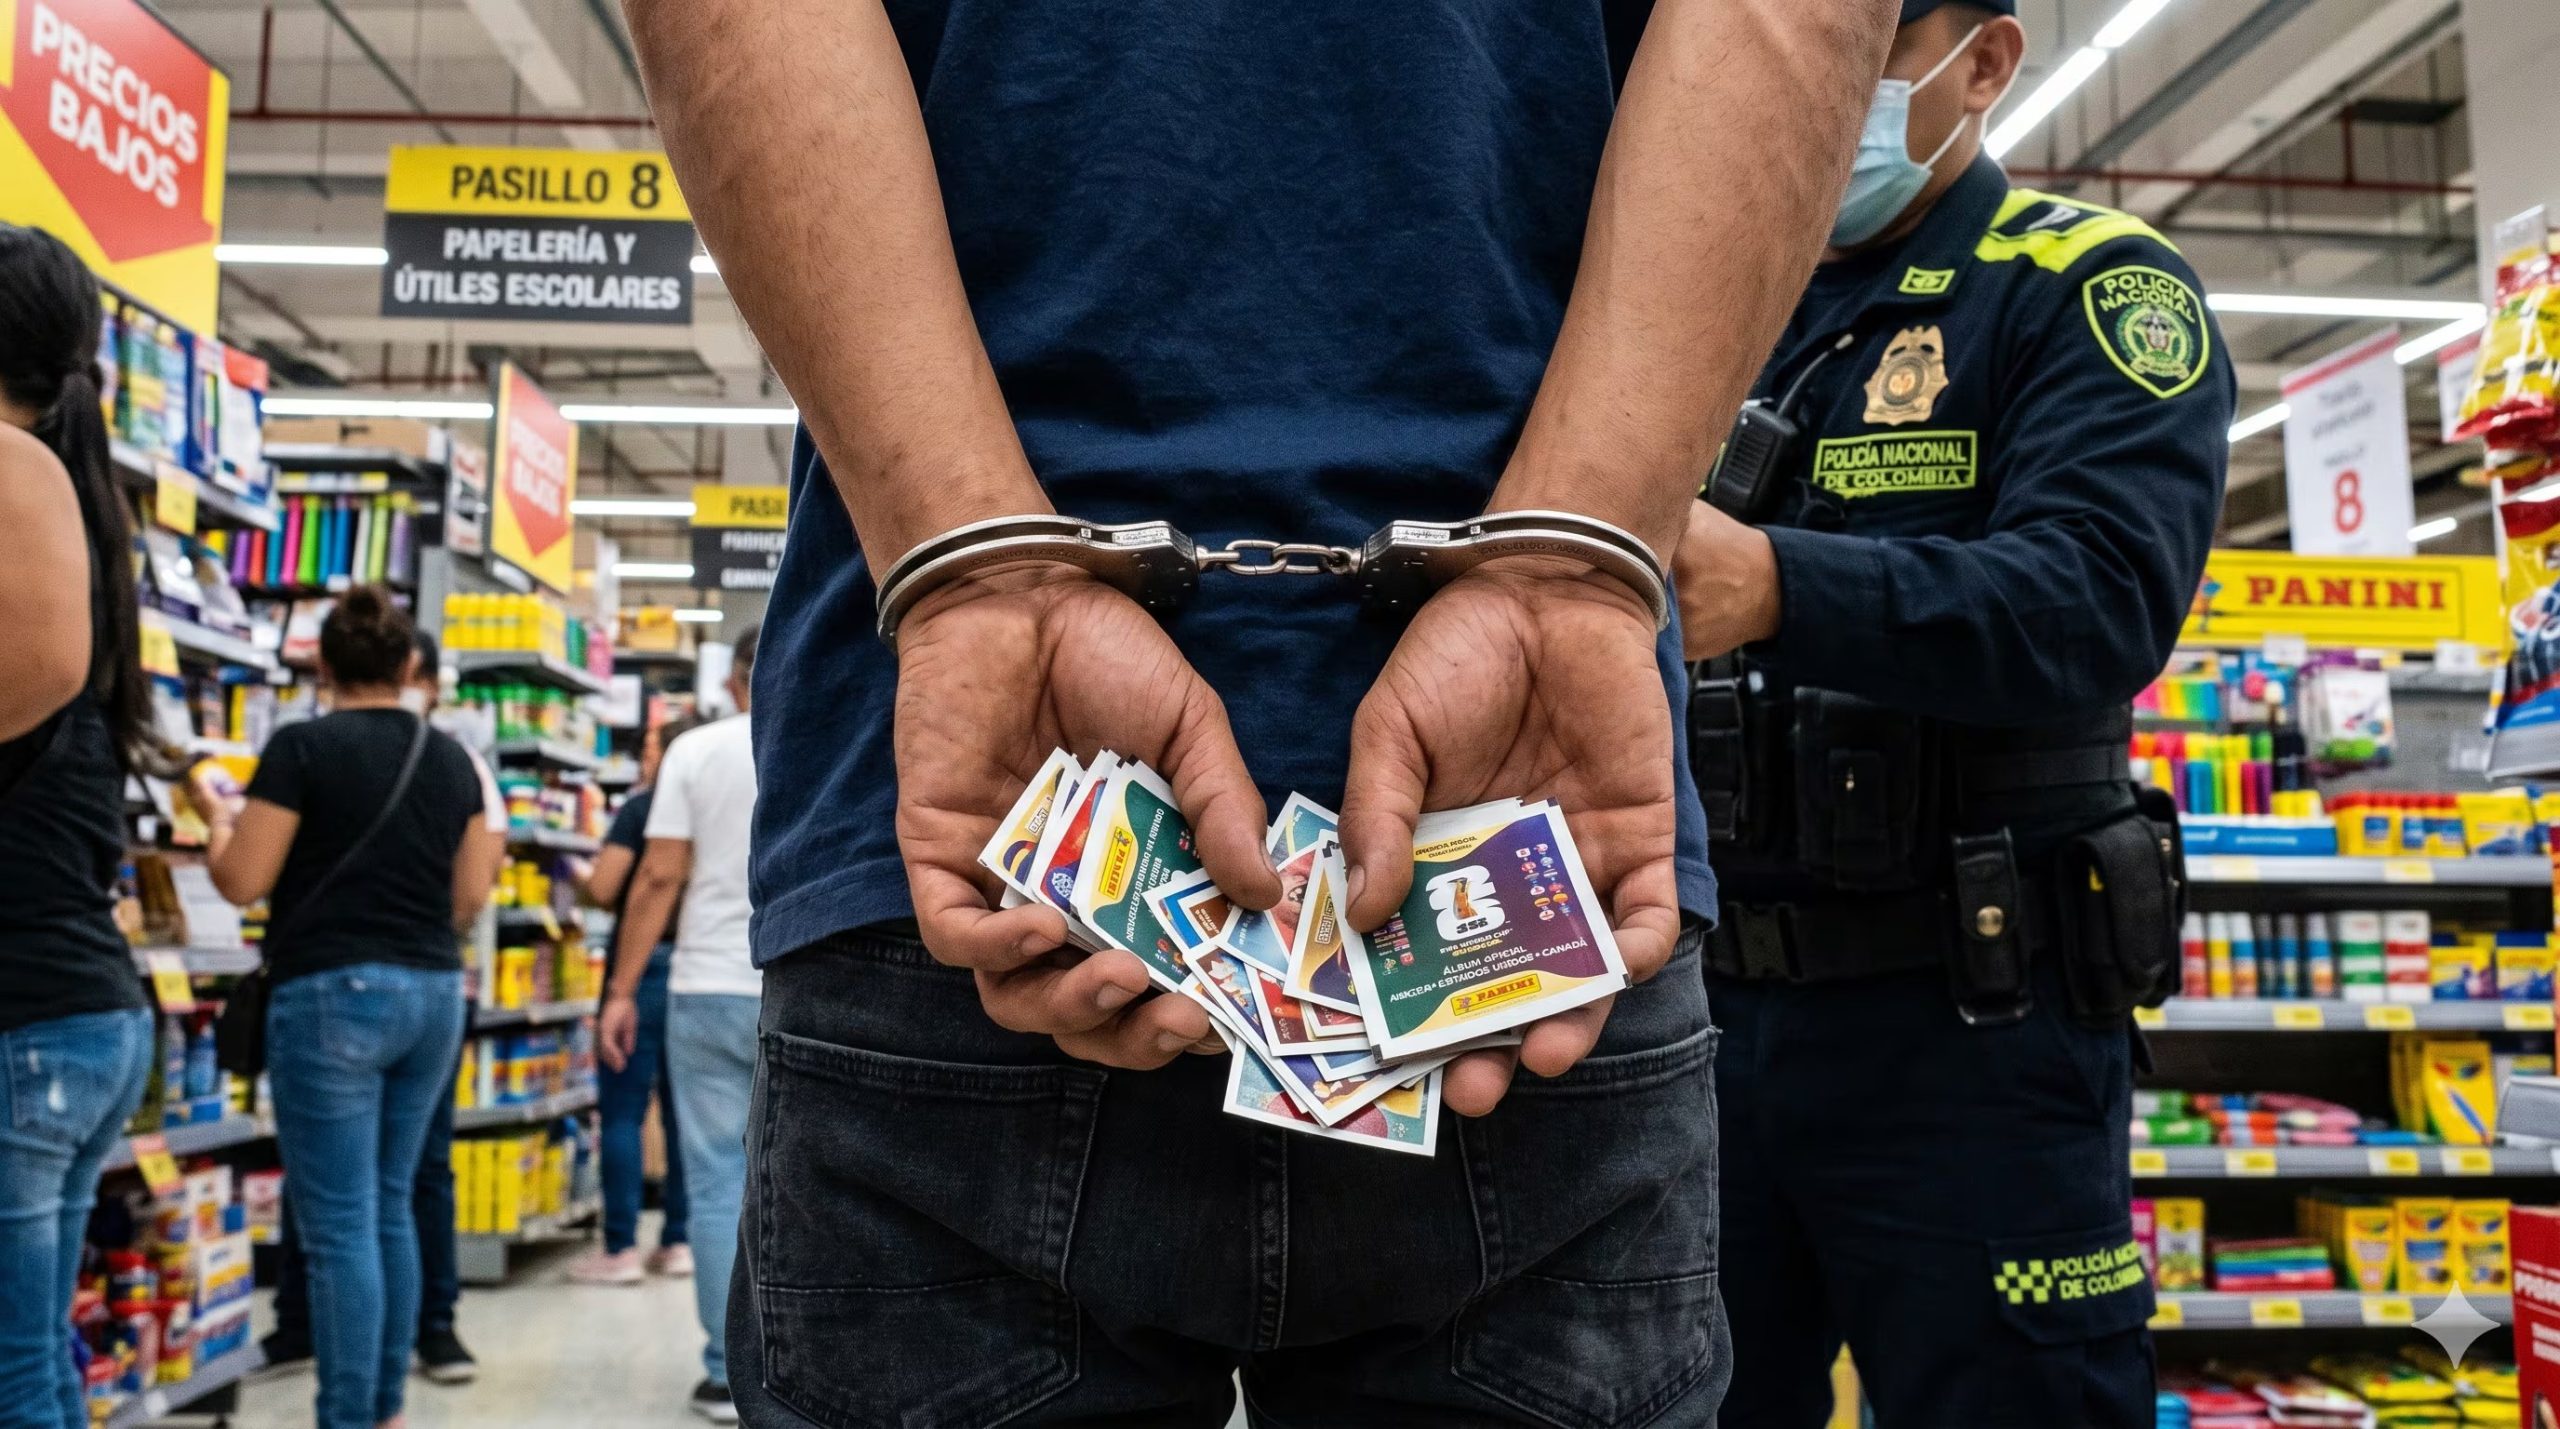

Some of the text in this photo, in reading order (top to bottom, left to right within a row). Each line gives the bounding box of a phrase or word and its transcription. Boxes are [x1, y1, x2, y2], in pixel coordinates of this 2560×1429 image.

[31, 2, 198, 164] PRECIOS
[49, 78, 179, 208] BAJOS
[451, 161, 660, 210] PASILLO 8
[443, 225, 637, 265] PAPELERÍA Y
[394, 263, 681, 311] ÚTILES ESCOLARES
[2098, 288, 2196, 324] NACIONAL
[1823, 441, 1968, 470] POLICÍA NACIONAL
[1824, 470, 1961, 489] DE COLOMBIA
[2334, 469, 2364, 534] 8
[2246, 575, 2446, 611] PANINI
[2051, 1247, 2114, 1277] POLICÍA
[2059, 1279, 2085, 1300] DE
